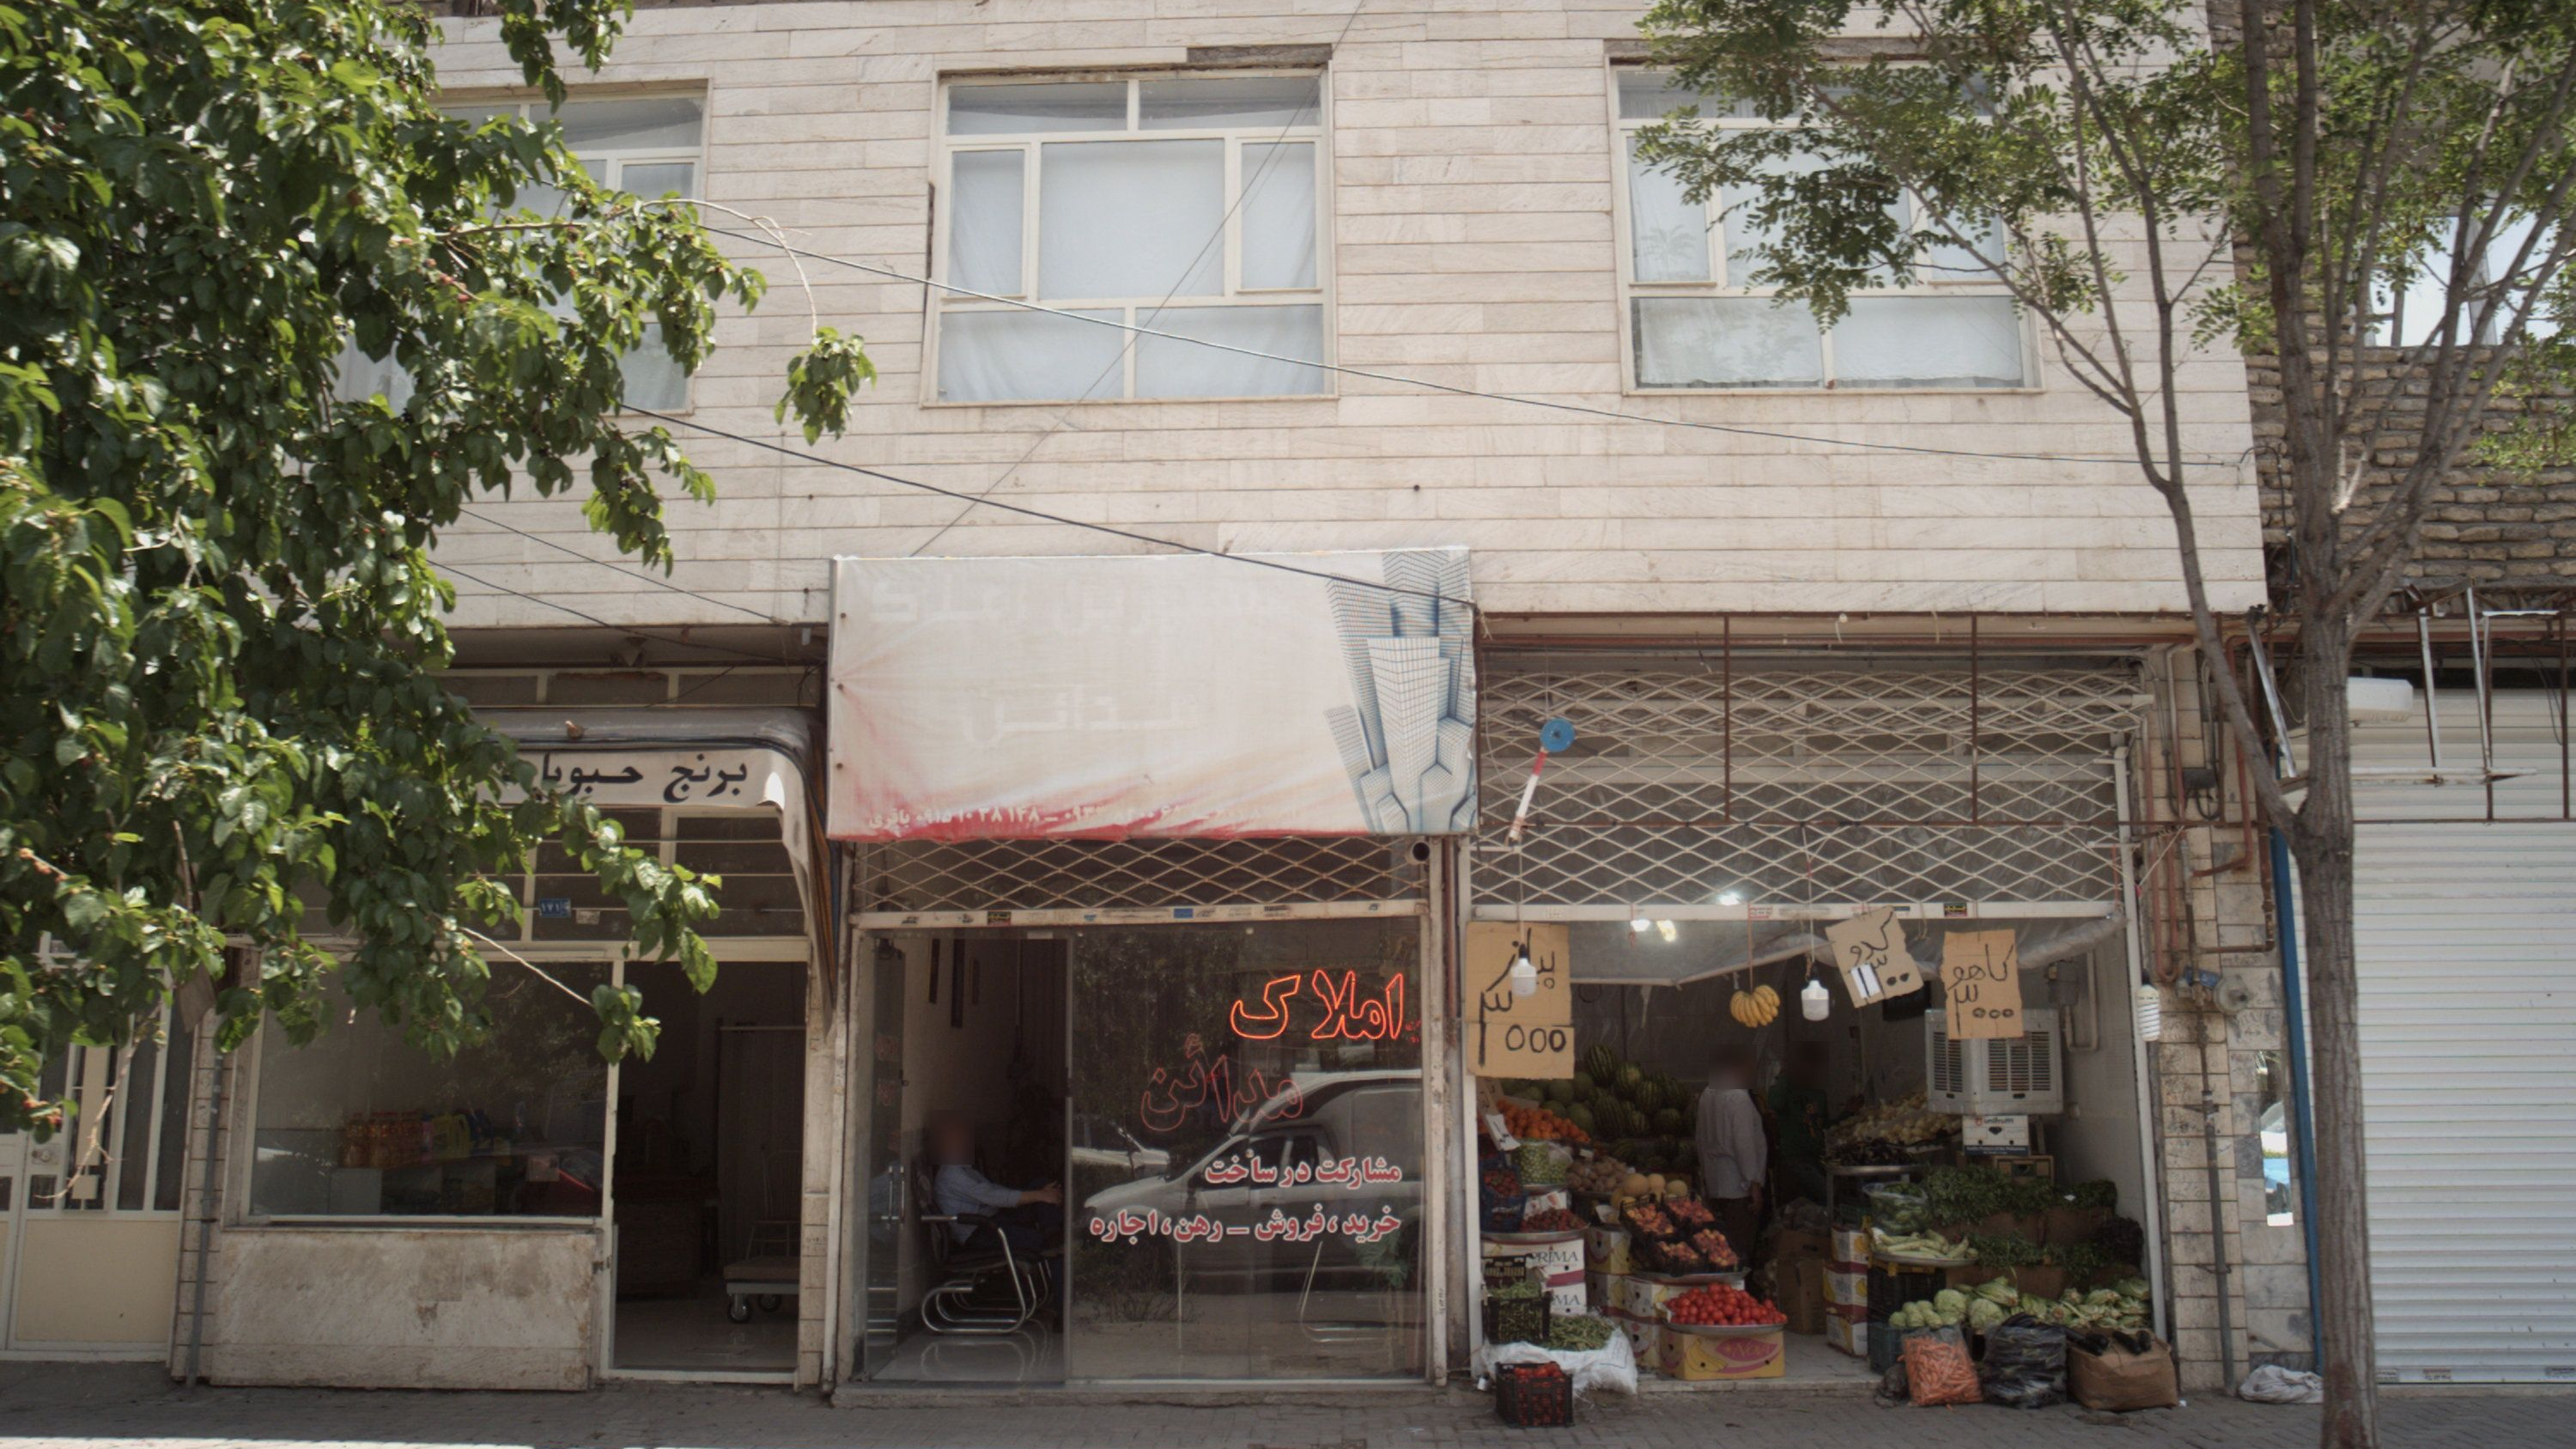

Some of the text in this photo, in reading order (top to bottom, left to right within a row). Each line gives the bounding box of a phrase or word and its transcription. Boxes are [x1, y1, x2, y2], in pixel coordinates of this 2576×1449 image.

[662, 753, 748, 803] برنج
[1947, 943, 2014, 990] کاهو
[1230, 970, 1405, 1040] املاک
[1205, 1154, 1402, 1190] مشارکت در ساخت
